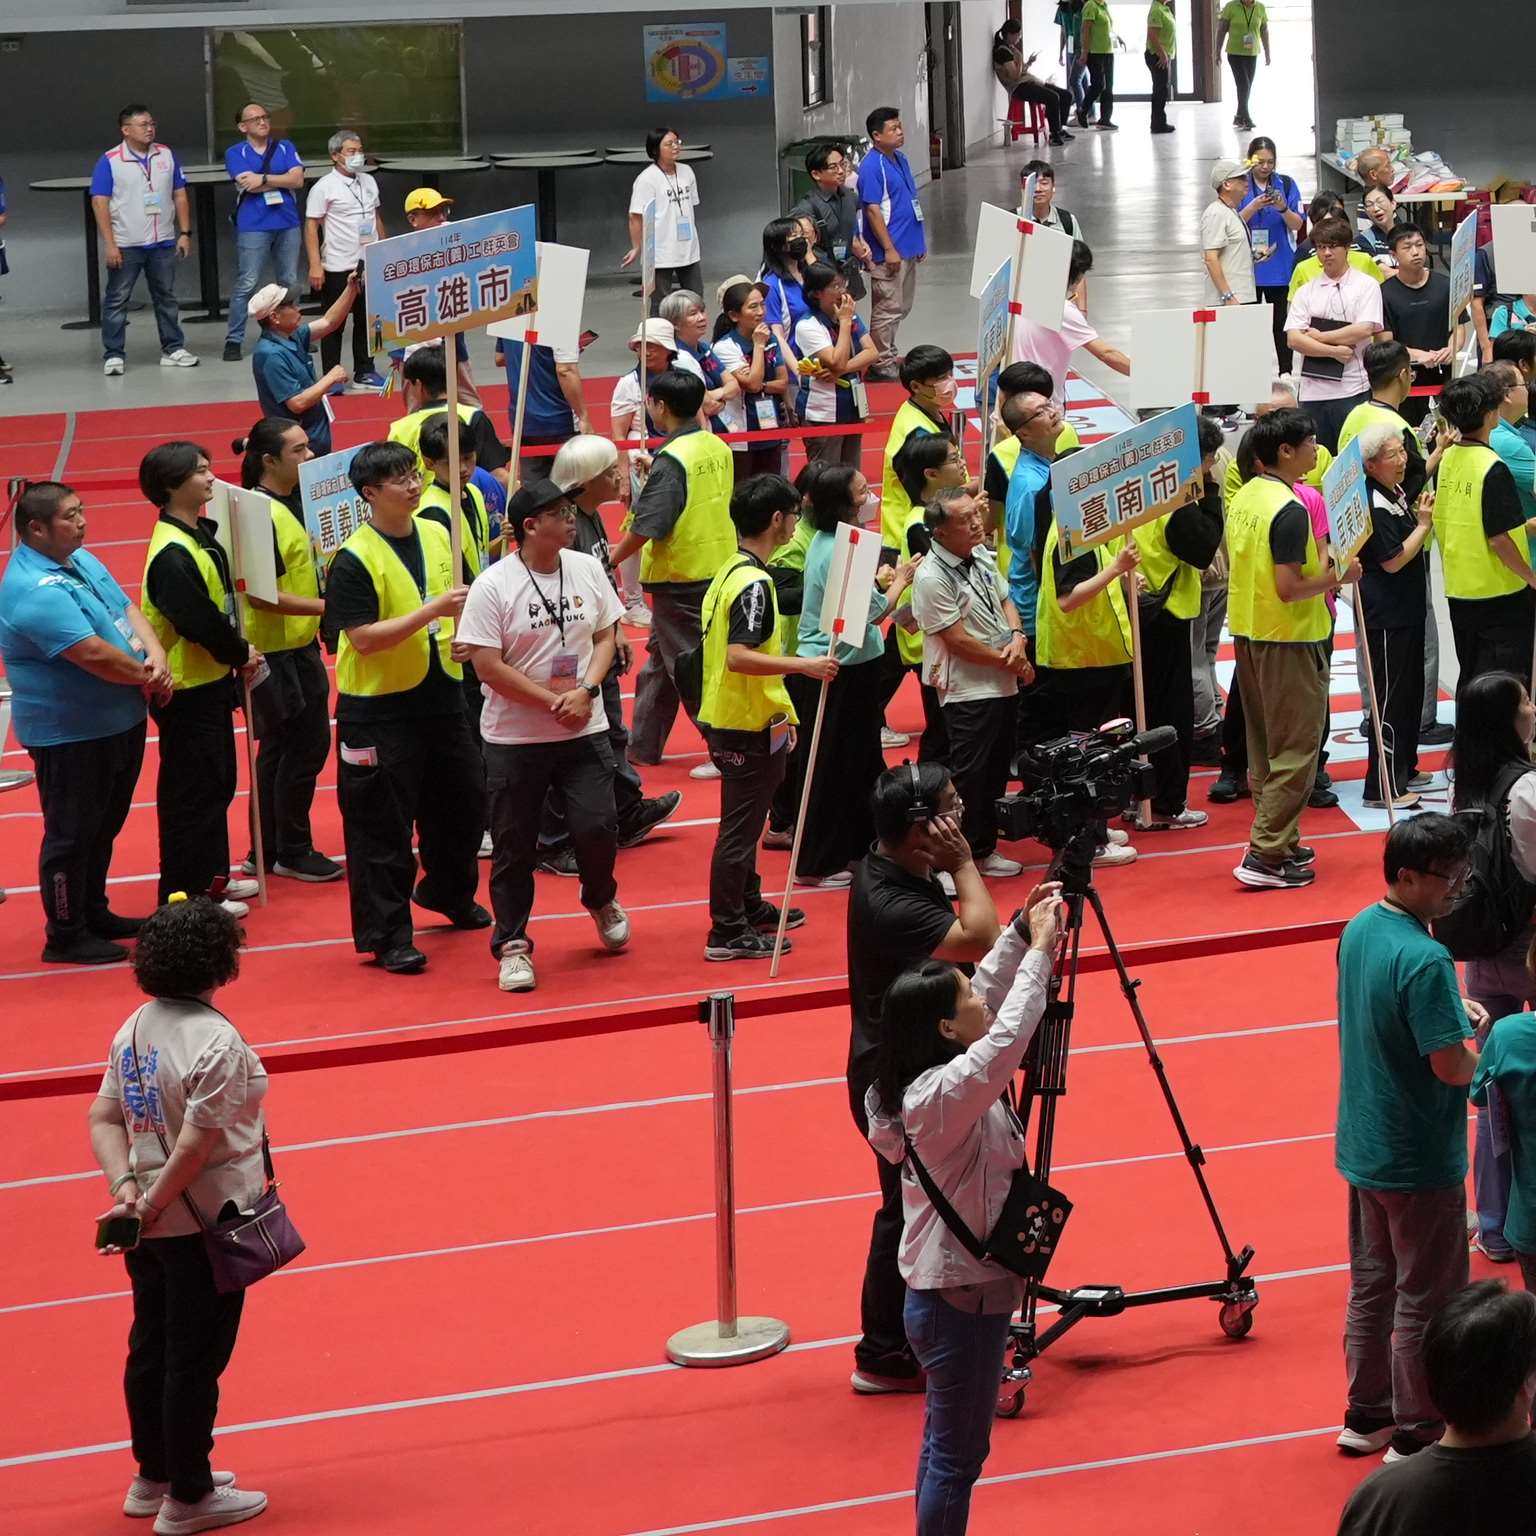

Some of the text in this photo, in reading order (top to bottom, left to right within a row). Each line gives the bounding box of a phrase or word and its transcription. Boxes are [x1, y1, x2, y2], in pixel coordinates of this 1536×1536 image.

[396, 267, 511, 334] 高雄市
[1079, 462, 1179, 540] 臺南市
